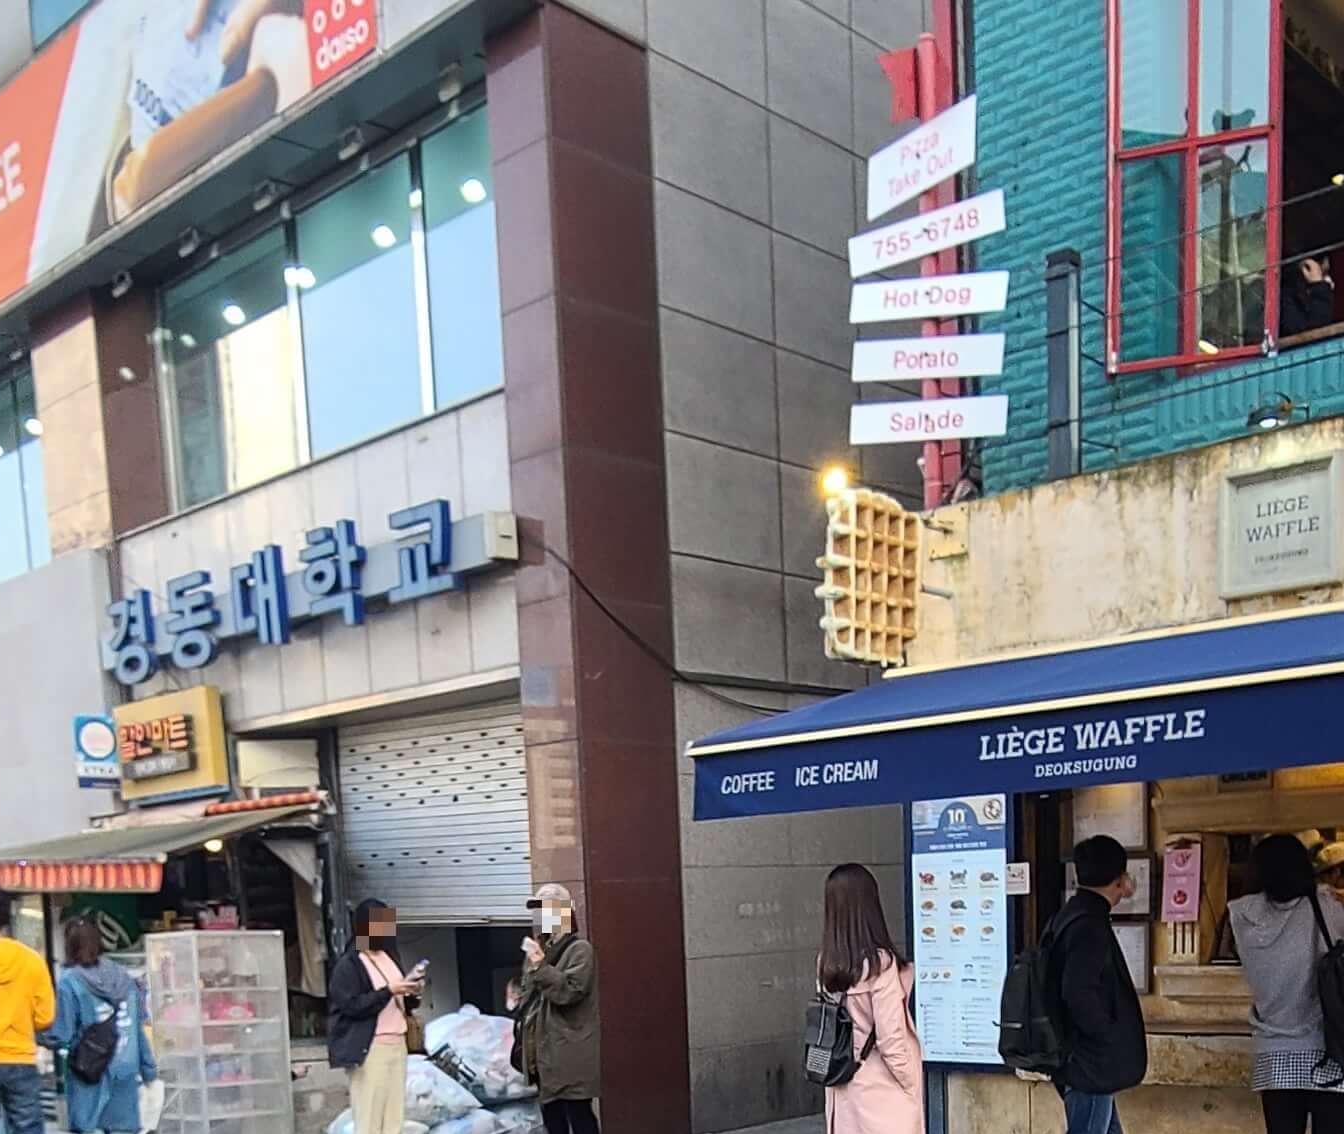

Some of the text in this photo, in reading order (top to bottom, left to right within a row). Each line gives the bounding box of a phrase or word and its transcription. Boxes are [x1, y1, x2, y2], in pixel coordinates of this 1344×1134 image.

[315, 19, 369, 71] daiso
[899, 128, 941, 166] Pizza
[887, 146, 954, 200] Take Out
[872, 207, 981, 260] 755-6748
[882, 284, 972, 309] Hot Dog
[893, 349, 960, 371] Potato
[888, 410, 965, 434] Salade
[1245, 516, 1321, 543] WAFFLE
[106, 498, 466, 686] 경동대학교
[980, 709, 1207, 761] LIÈGE WAFFLE
[720, 760, 879, 796] COFFEE ICE CREAM
[1034, 754, 1138, 779] DEOKSUGUNG
